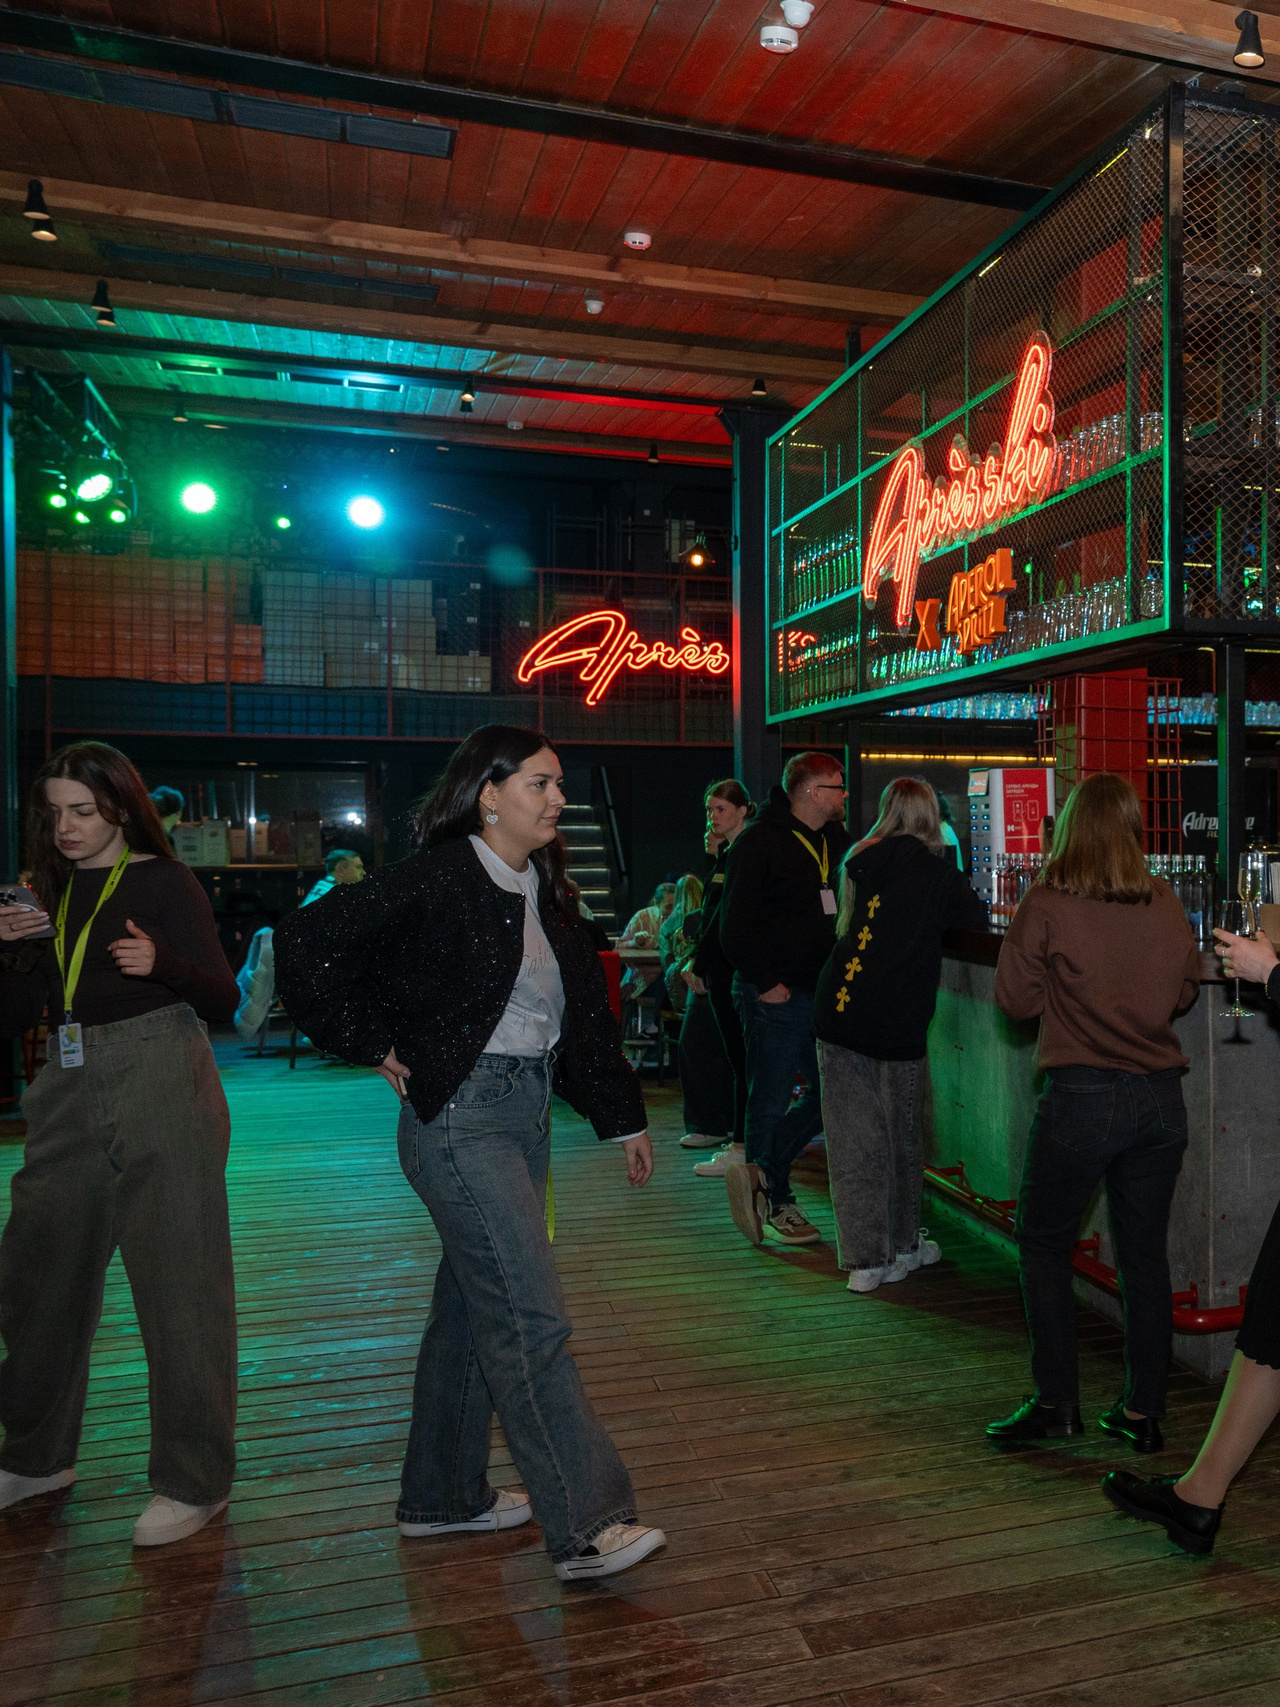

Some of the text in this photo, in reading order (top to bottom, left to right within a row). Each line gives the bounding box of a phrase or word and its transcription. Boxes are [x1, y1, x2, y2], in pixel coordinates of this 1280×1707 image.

[946, 548, 1016, 633] APEROL
[956, 594, 1007, 655] SPRITZ
[517, 610, 731, 706] Après
